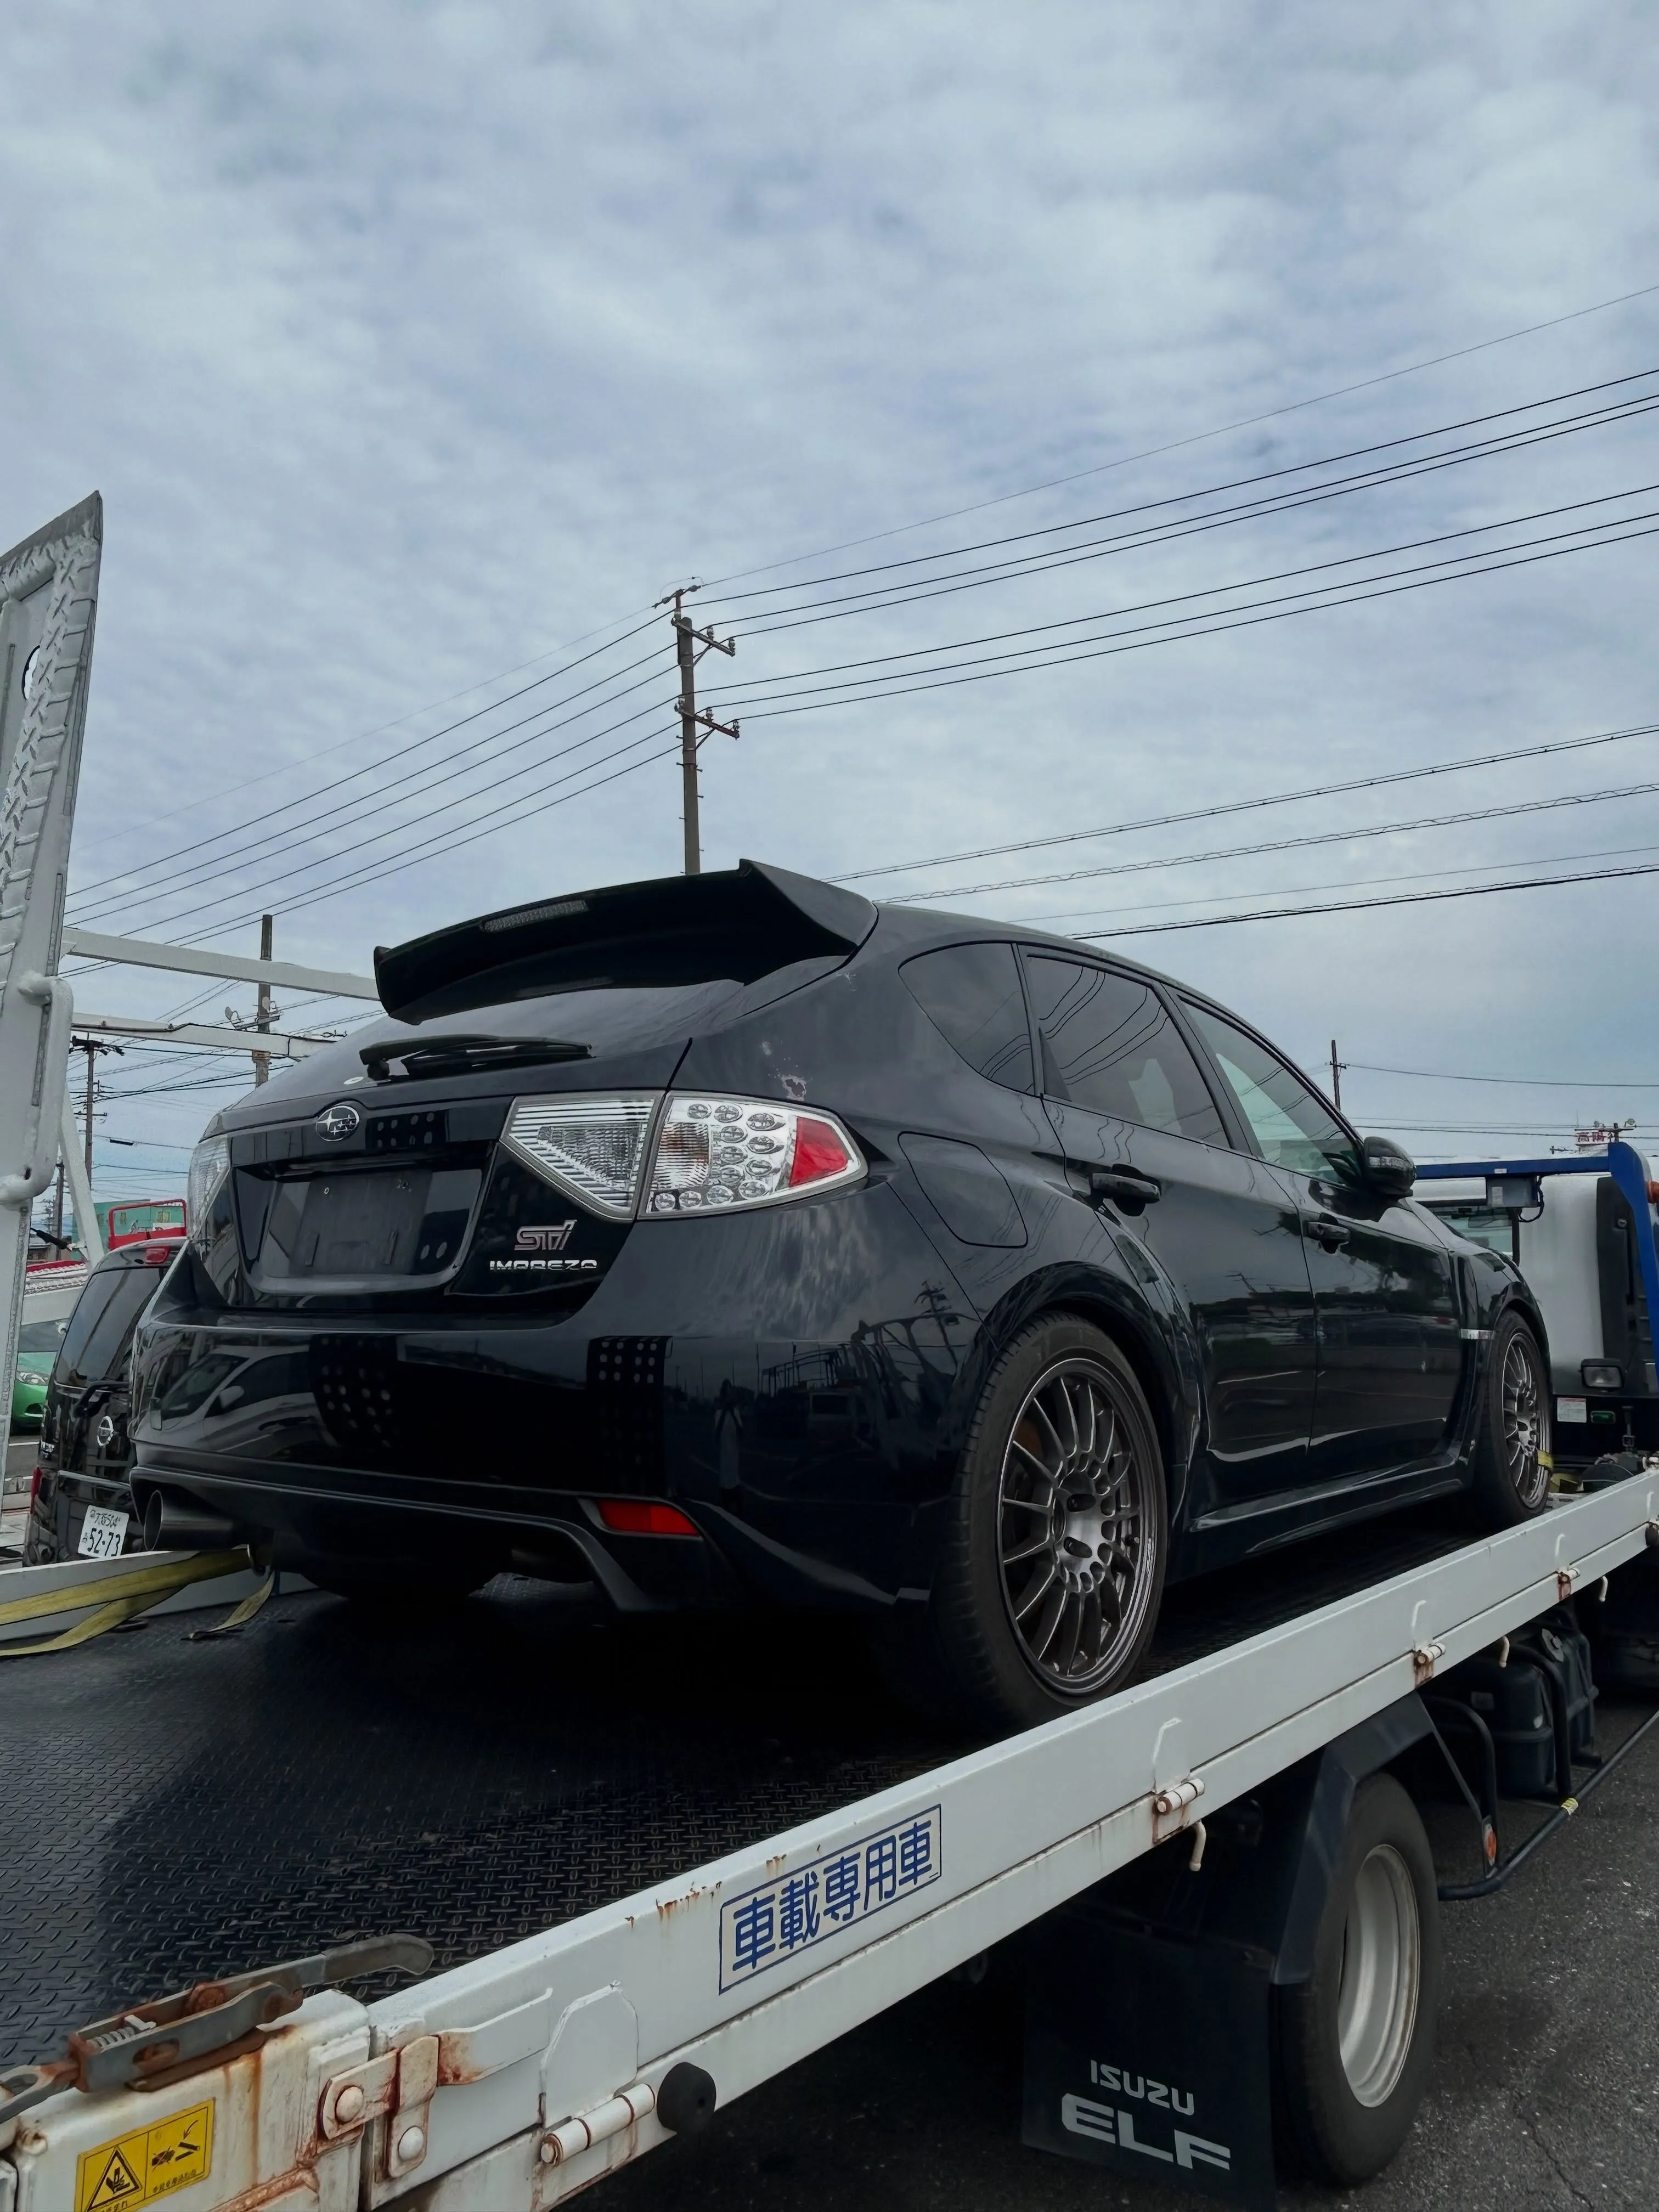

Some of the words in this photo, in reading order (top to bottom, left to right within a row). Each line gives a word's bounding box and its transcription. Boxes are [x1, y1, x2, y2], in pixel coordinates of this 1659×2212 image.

[490, 1260, 597, 1271] IMPREZA
[732, 1820, 932, 1971] 車載専用車
[1091, 2059, 1194, 2116] ISUZU
[1062, 2093, 1231, 2170] ELF
